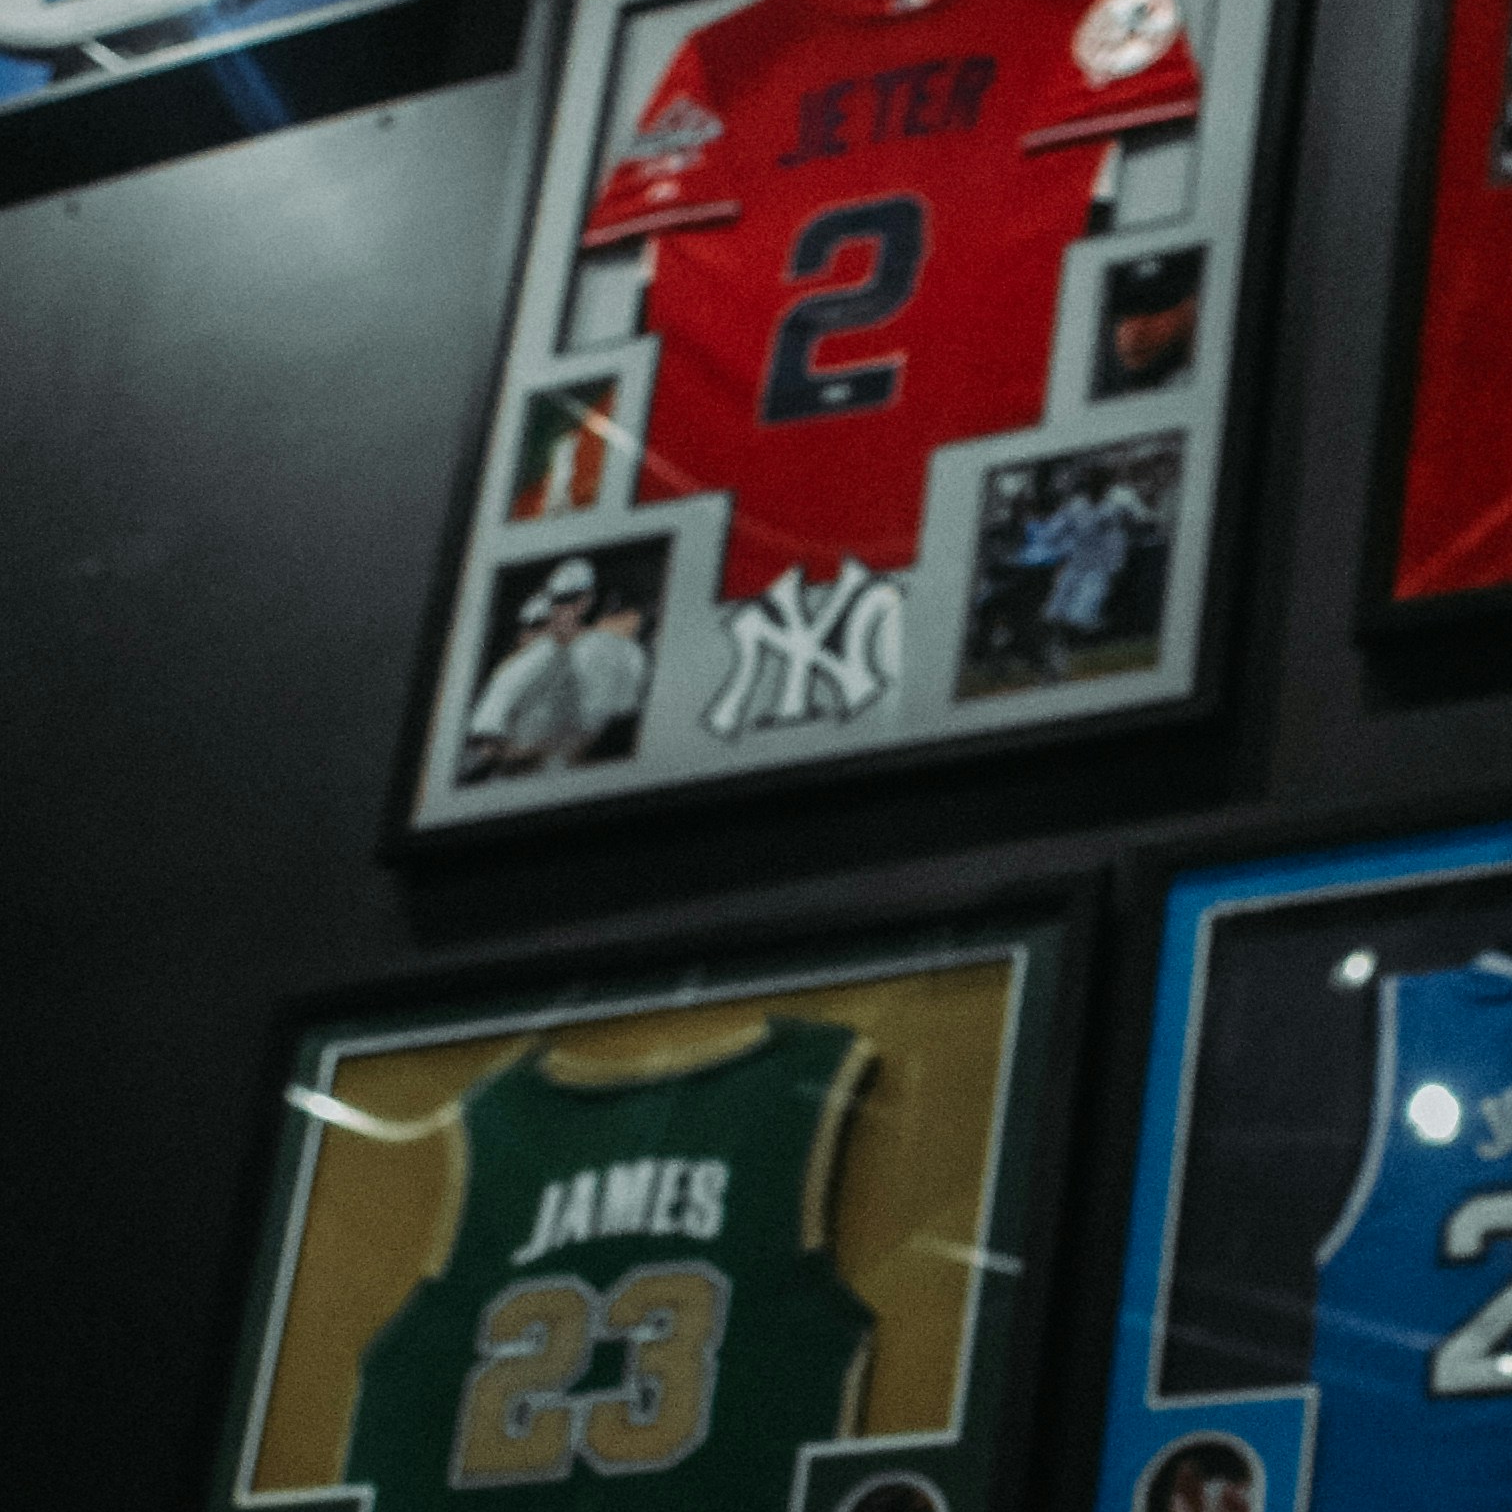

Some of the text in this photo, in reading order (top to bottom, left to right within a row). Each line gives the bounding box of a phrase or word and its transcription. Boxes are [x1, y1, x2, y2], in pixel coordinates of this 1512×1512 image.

[776, 55, 997, 169] JETER
[755, 191, 935, 431] 2
[512, 1156, 730, 1266] JAMES
[447, 1258, 734, 1490] 23
